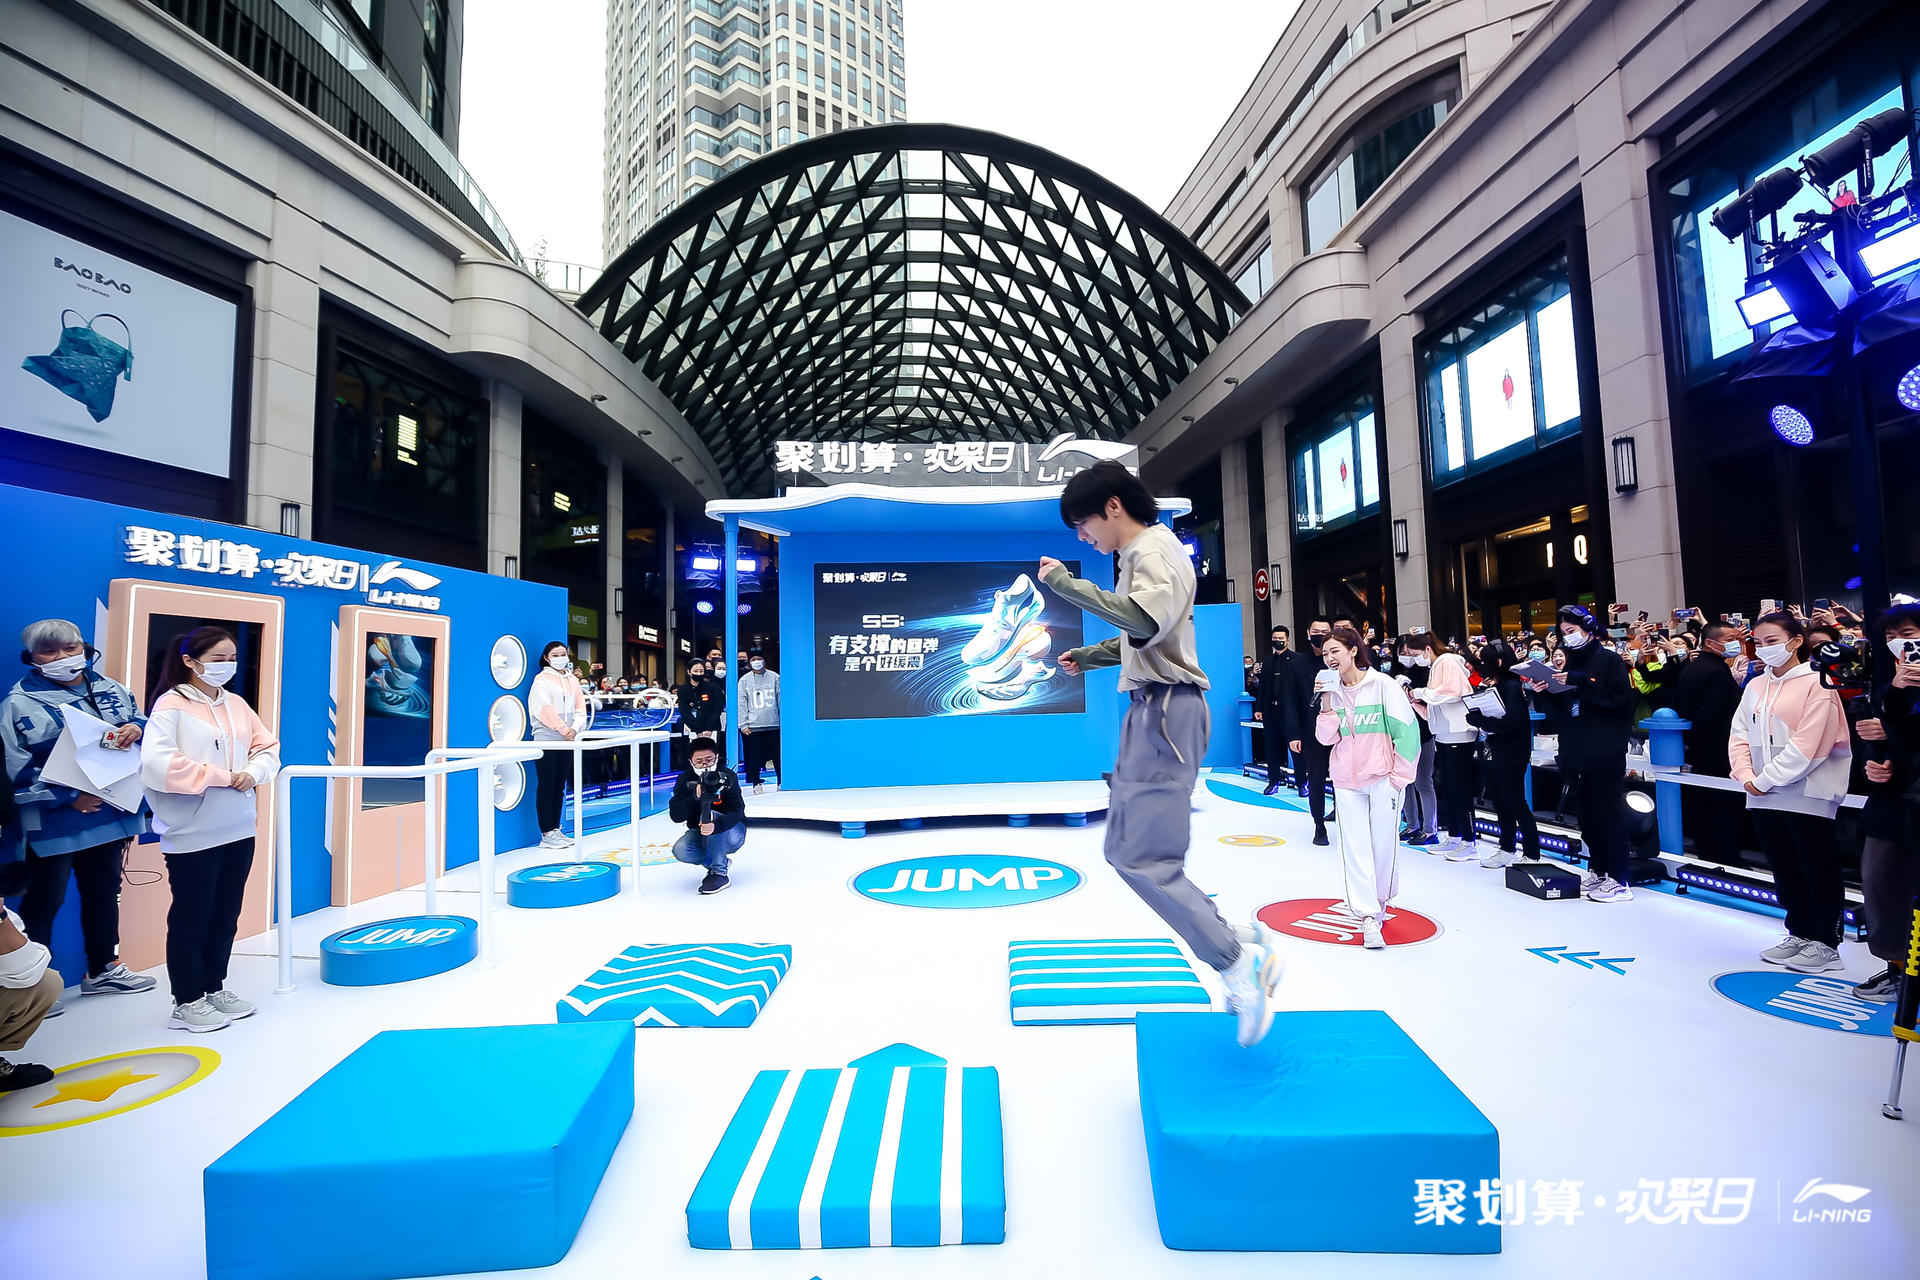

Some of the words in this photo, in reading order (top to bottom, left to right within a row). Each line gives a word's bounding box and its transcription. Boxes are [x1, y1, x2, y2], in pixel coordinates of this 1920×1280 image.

[828, 633, 940, 655] 有支撑的回弹
[844, 654, 923, 672] 是个好缓震
[866, 866, 1065, 894] JUMP
[339, 928, 457, 945] JUMP
